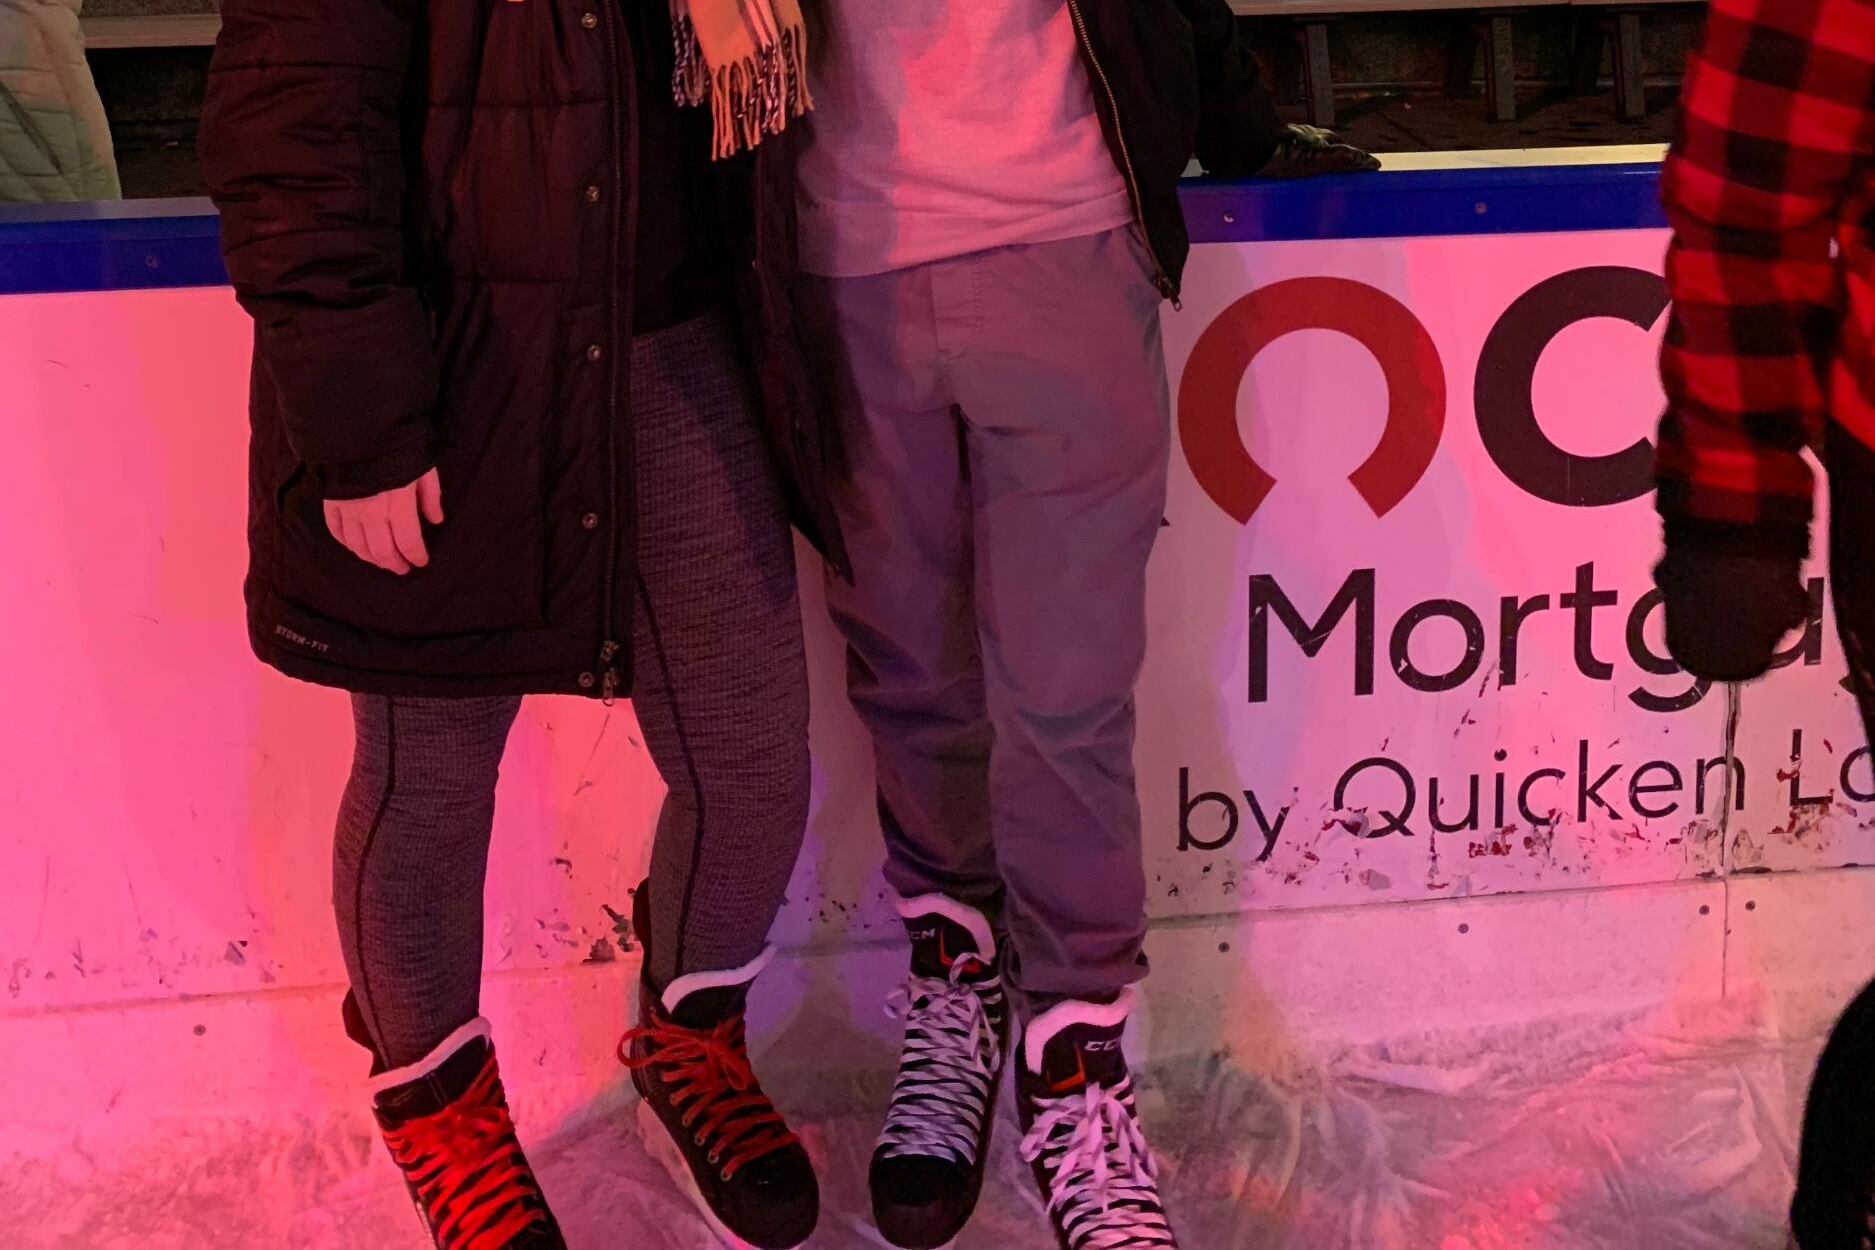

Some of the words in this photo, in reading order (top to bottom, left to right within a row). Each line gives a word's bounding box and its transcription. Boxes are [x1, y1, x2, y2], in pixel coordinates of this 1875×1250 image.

[274, 624, 329, 653] STORM-FIT
[1177, 767, 1297, 862] by
[1333, 739, 1746, 838] Quicken
[1789, 728, 1875, 807] Lo
